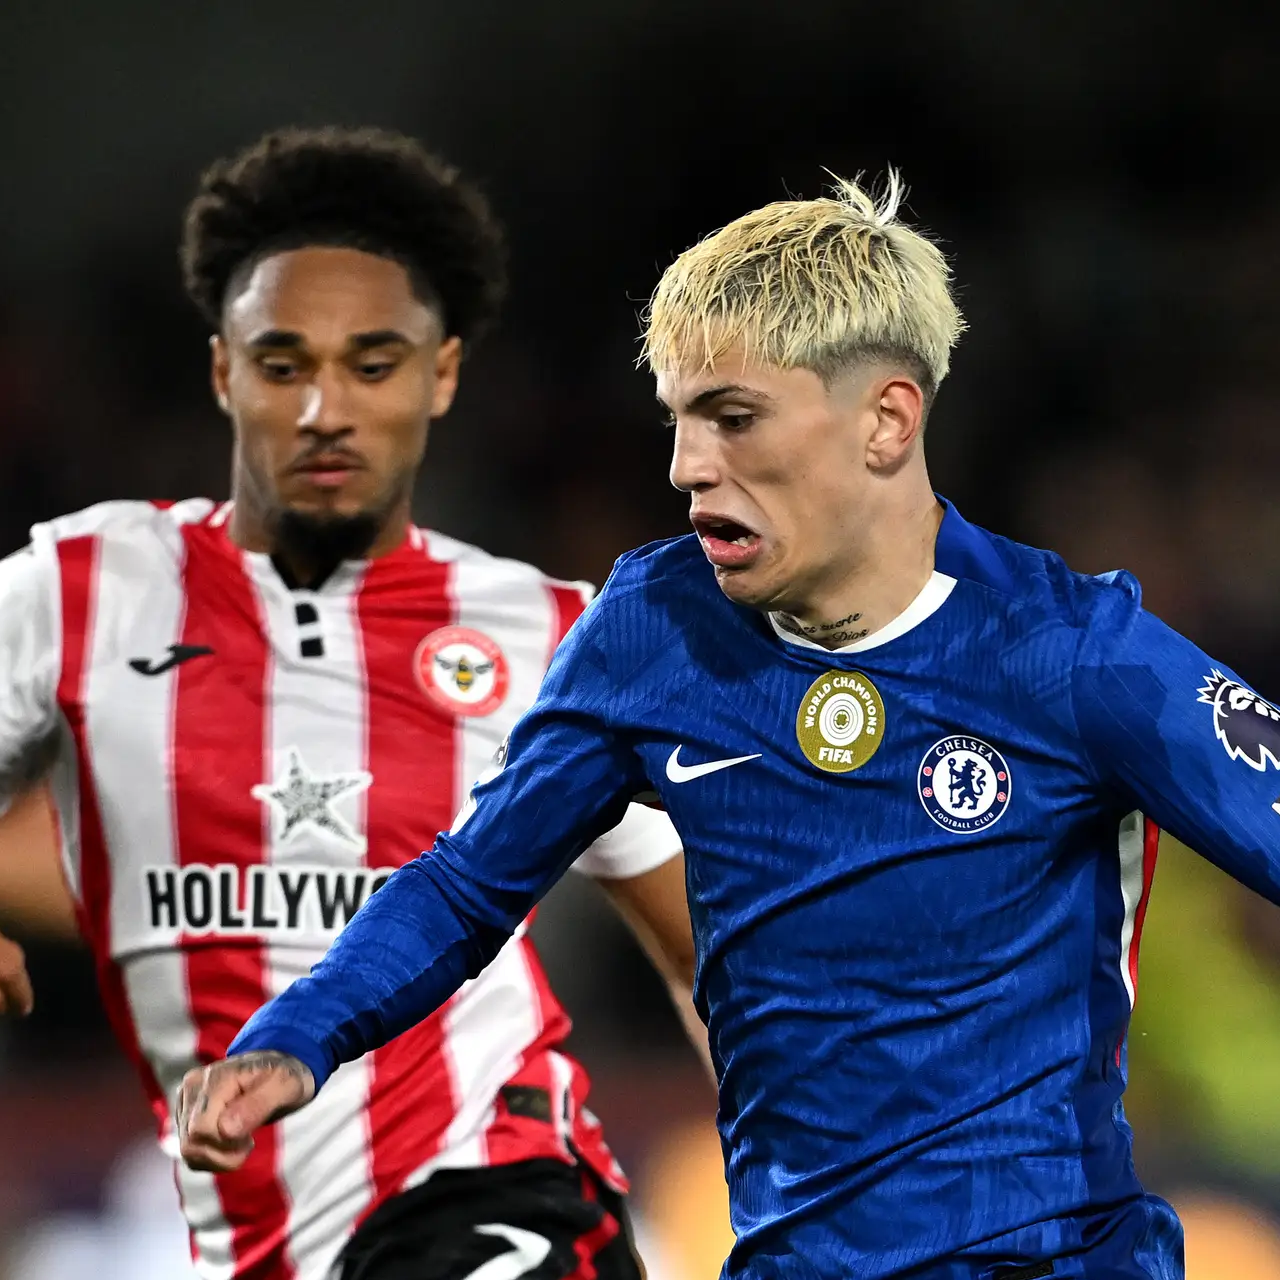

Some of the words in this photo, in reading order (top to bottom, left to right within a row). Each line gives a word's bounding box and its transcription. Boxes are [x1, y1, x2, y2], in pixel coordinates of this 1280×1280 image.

[805, 683, 832, 728] WORLD
[833, 677, 878, 736] CHAMPIONS
[818, 746, 853, 764] FIFA
[935, 739, 994, 762] CHELSEA
[933, 809, 971, 829] FOOTBALL
[974, 812, 995, 827] CLUB
